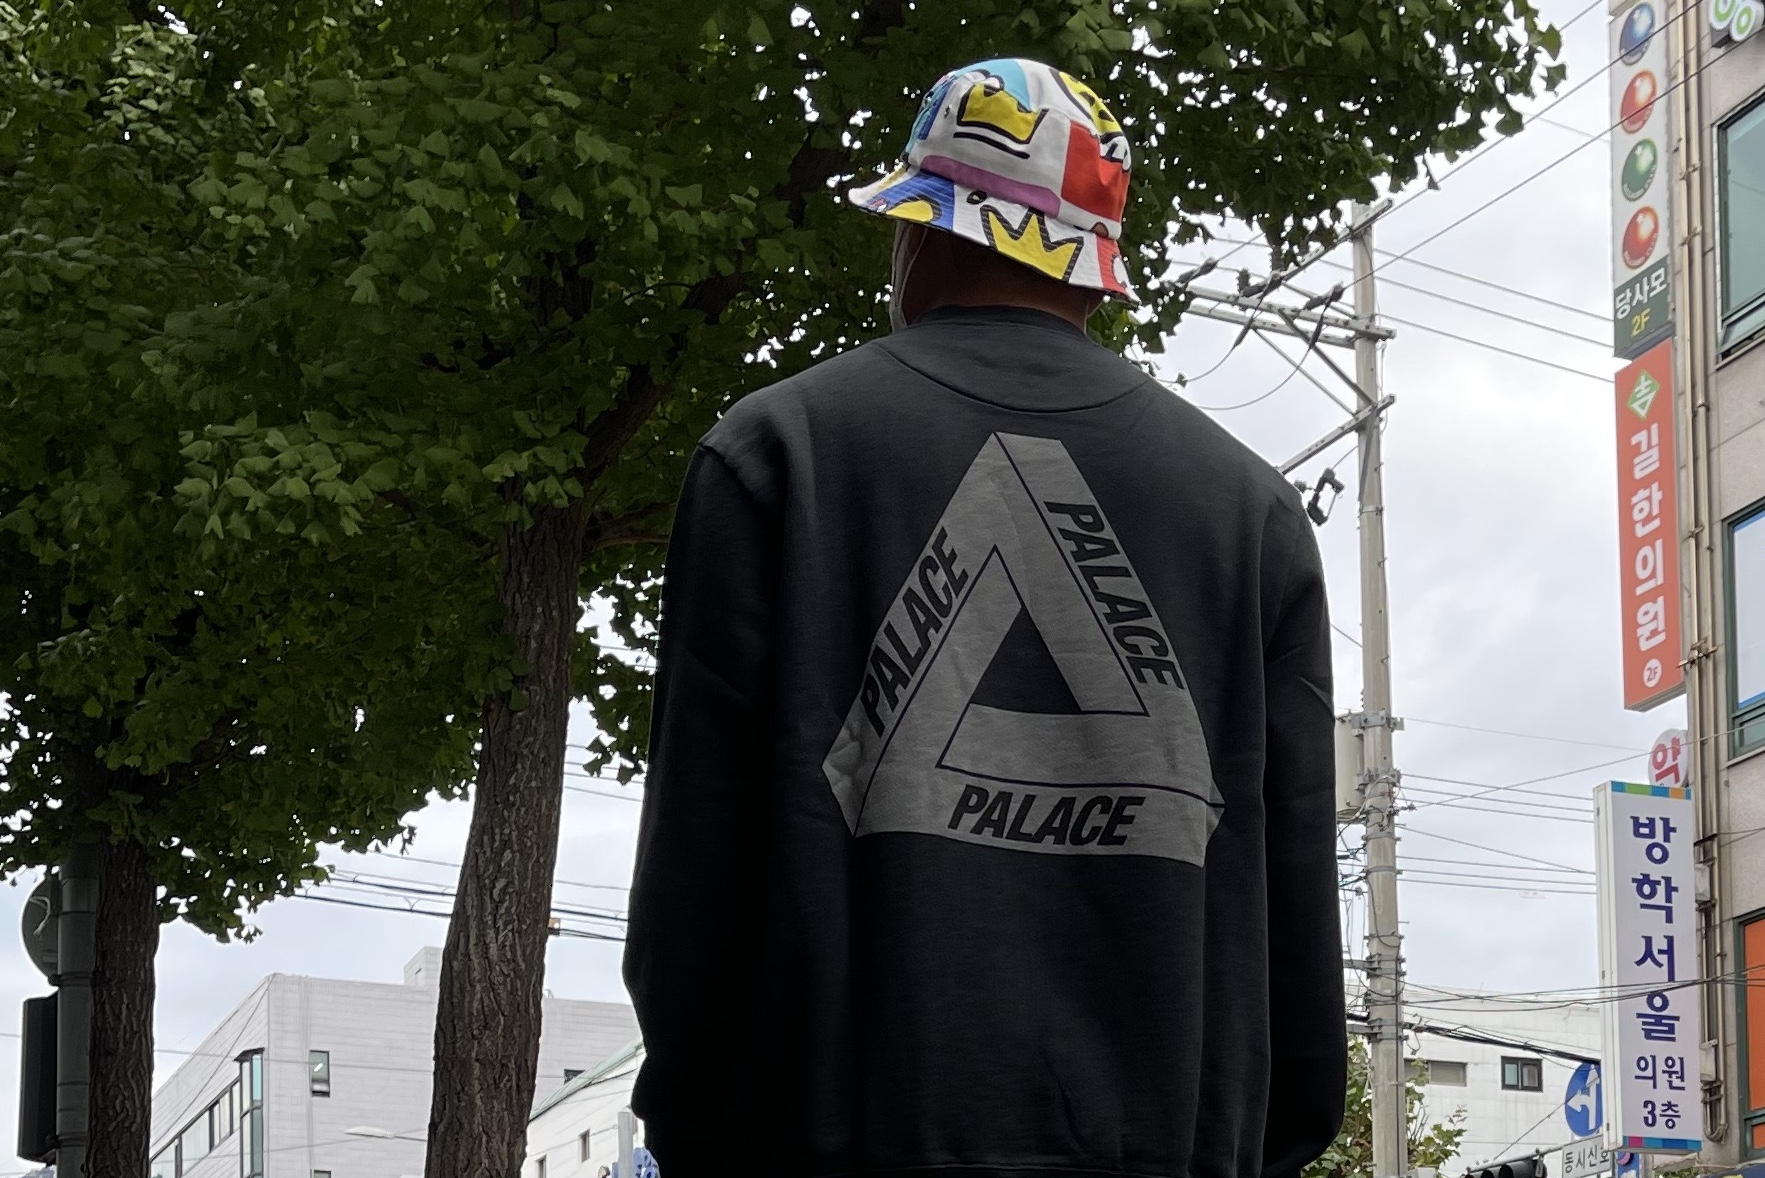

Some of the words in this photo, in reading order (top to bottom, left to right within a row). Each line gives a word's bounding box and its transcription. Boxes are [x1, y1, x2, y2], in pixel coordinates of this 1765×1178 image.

[1616, 267, 1668, 320] 당사모
[1631, 308, 1650, 337] 2F
[1630, 423, 1667, 652] 길한의원
[1043, 501, 1185, 690] PALACE
[860, 526, 969, 738] PALACE
[1646, 665, 1659, 683] 2F
[1652, 736, 1681, 784] 약
[947, 784, 1146, 846] PALACE
[1630, 815, 1680, 1042] 방학서울
[1634, 1054, 1686, 1091] 의원
[1642, 1099, 1681, 1130] 3층
[1564, 1144, 1610, 1174] 동시신호
